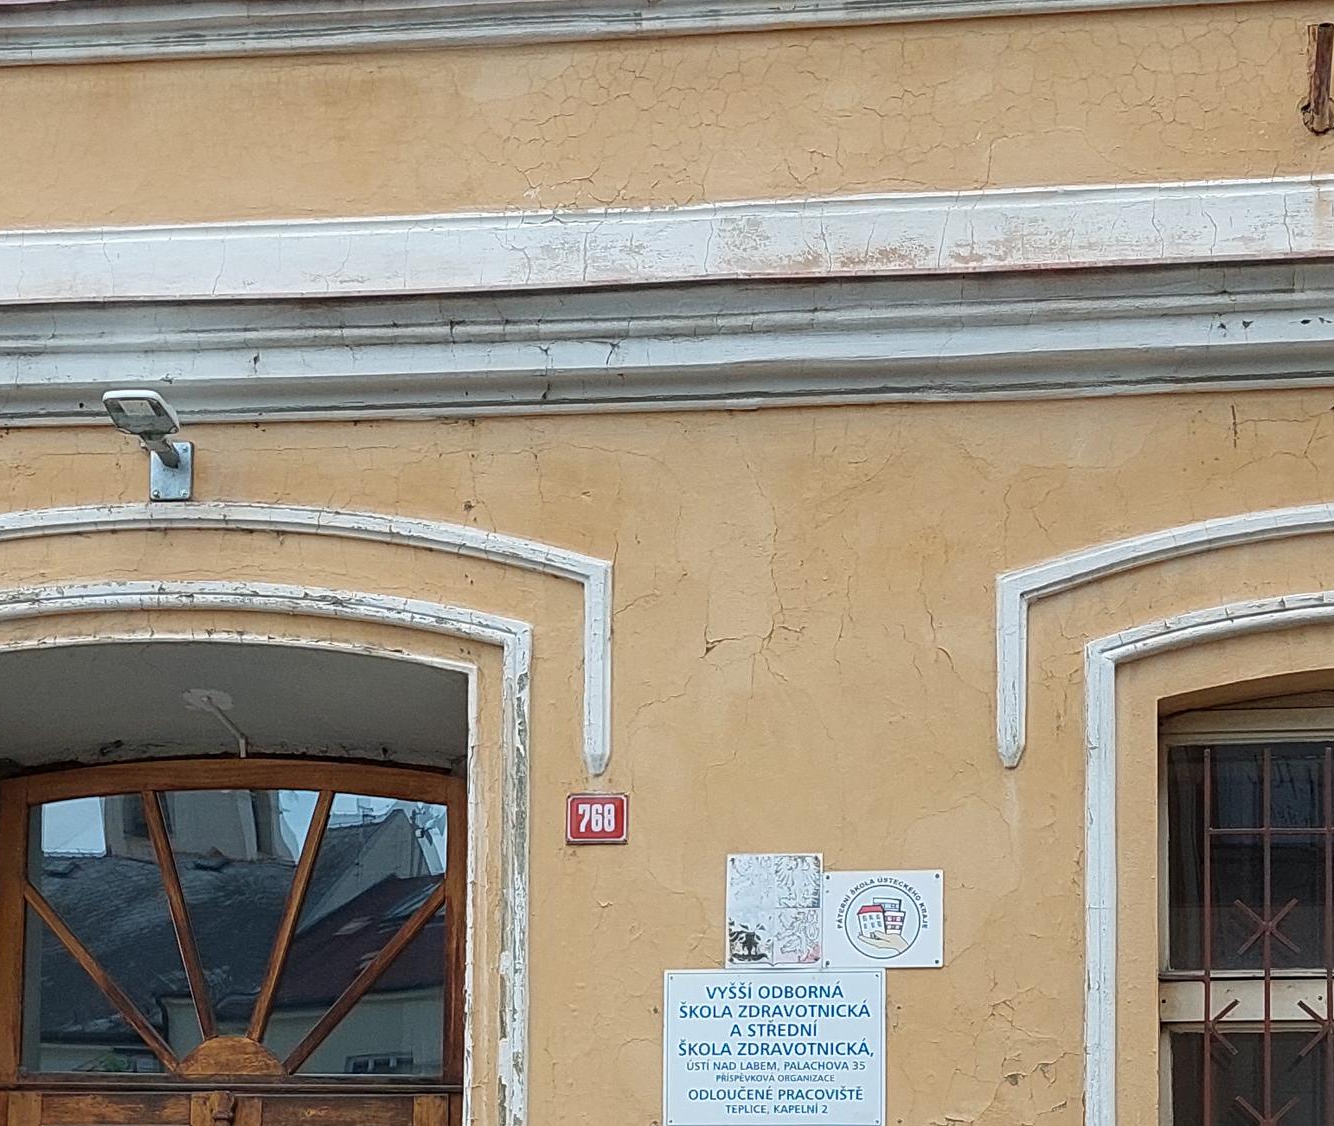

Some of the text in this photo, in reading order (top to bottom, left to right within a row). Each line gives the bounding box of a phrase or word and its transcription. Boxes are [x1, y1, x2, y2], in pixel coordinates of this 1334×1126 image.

[578, 803, 616, 833] 768
[706, 980, 844, 999] VYŠŠÍ ODBORNÁ
[679, 998, 871, 1018] ŠKOLA ZDRAVOTNICKÁ
[729, 1019, 818, 1037] A STŘEDNÍ
[678, 1037, 874, 1058] ŠKOLA ZDRAVOTNICKÁ,
[686, 1058, 866, 1072] ÚSTÍ NAD LABEM, PALACHOVA 35
[715, 1071, 835, 1083] PŘÍSPĚVKOVÁ ORGANIZACE
[688, 1085, 864, 1101] ODLOUČENÉ PRACOVIŠTĚ
[725, 1102, 829, 1115] TEPLICE, KAPELNÍ 2
